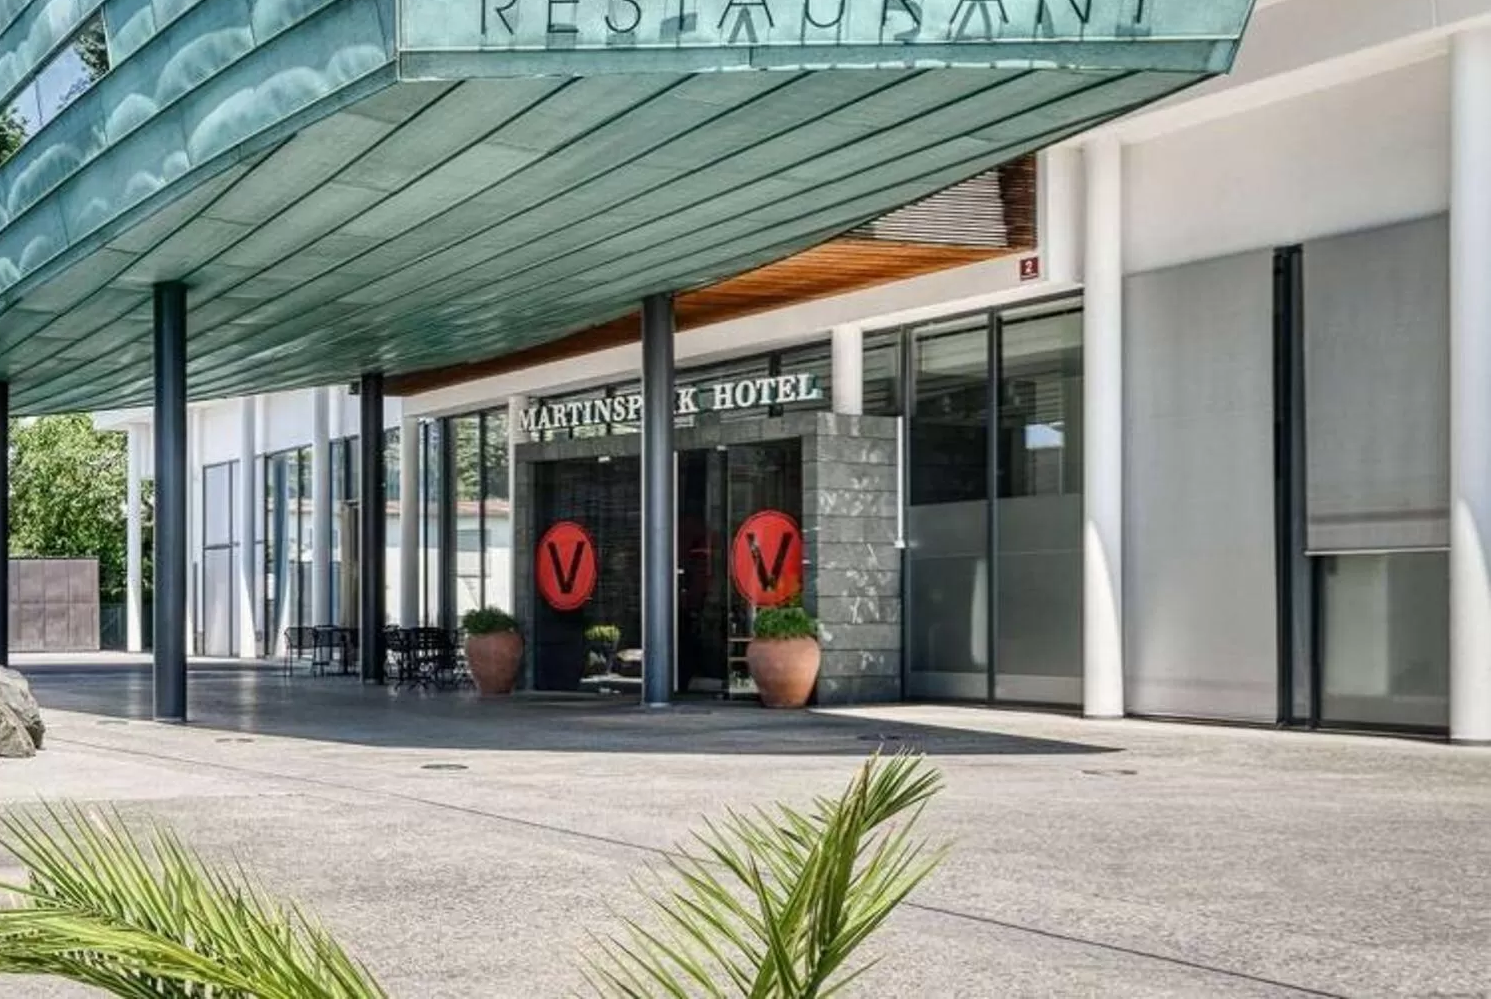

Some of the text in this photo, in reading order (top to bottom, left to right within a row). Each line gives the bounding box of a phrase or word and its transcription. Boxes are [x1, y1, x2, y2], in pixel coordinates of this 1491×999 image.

[518, 372, 820, 432] MARTINSPK HOTEL
[547, 541, 586, 594] V
[746, 531, 794, 593] V
